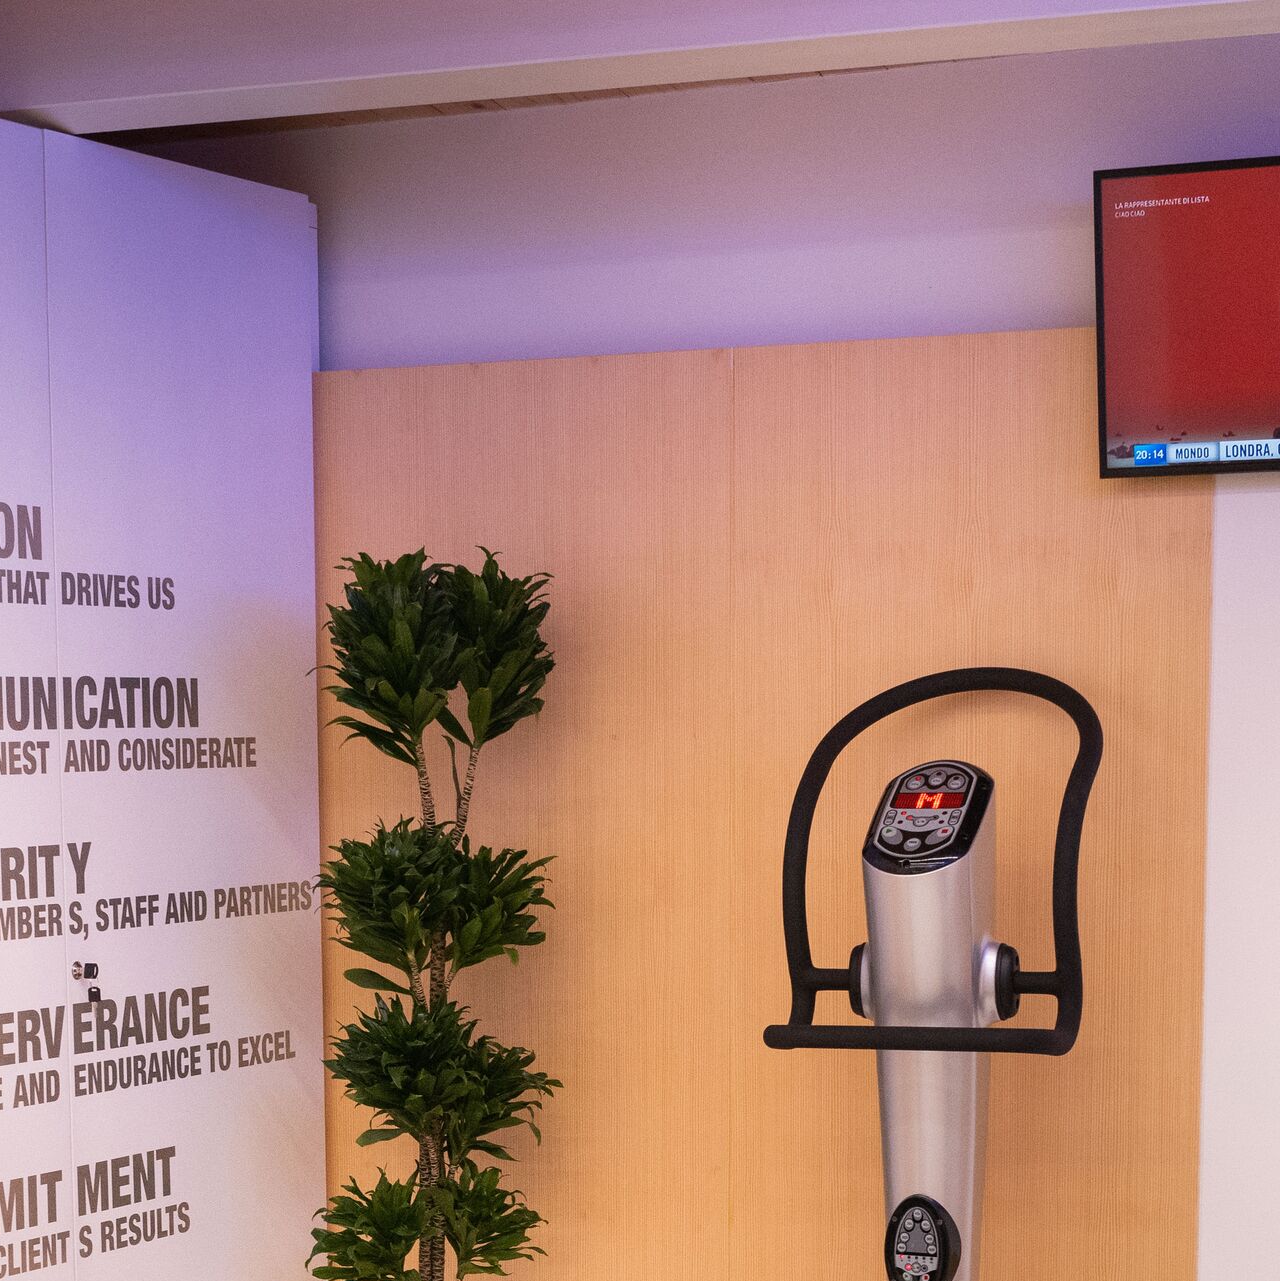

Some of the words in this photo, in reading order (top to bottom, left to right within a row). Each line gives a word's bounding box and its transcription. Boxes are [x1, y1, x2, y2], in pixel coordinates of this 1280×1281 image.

[1114, 210, 1130, 218] CIAO
[1130, 209, 1146, 217] CIAO
[1124, 197, 1182, 208] RAPPRESENTANTE
[1182, 197, 1191, 205] DI
[1191, 195, 1210, 204] LISTA
[1135, 449, 1164, 460] 20:14
[1175, 447, 1210, 460] MONDO
[61, 571, 141, 609] DRIVES
[147, 577, 176, 611] US
[64, 738, 111, 773] AND
[118, 736, 257, 771] CONSIDERATE
[95, 894, 160, 932] STAFF
[165, 890, 208, 925] AND
[214, 880, 313, 920] PARTNERS
[13, 1070, 60, 1109] AND
[74, 1046, 202, 1098] ENDURANCE
[206, 1041, 232, 1074] TO
[237, 1030, 296, 1067] EXCEL
[100, 1201, 191, 1254] RESULTS
